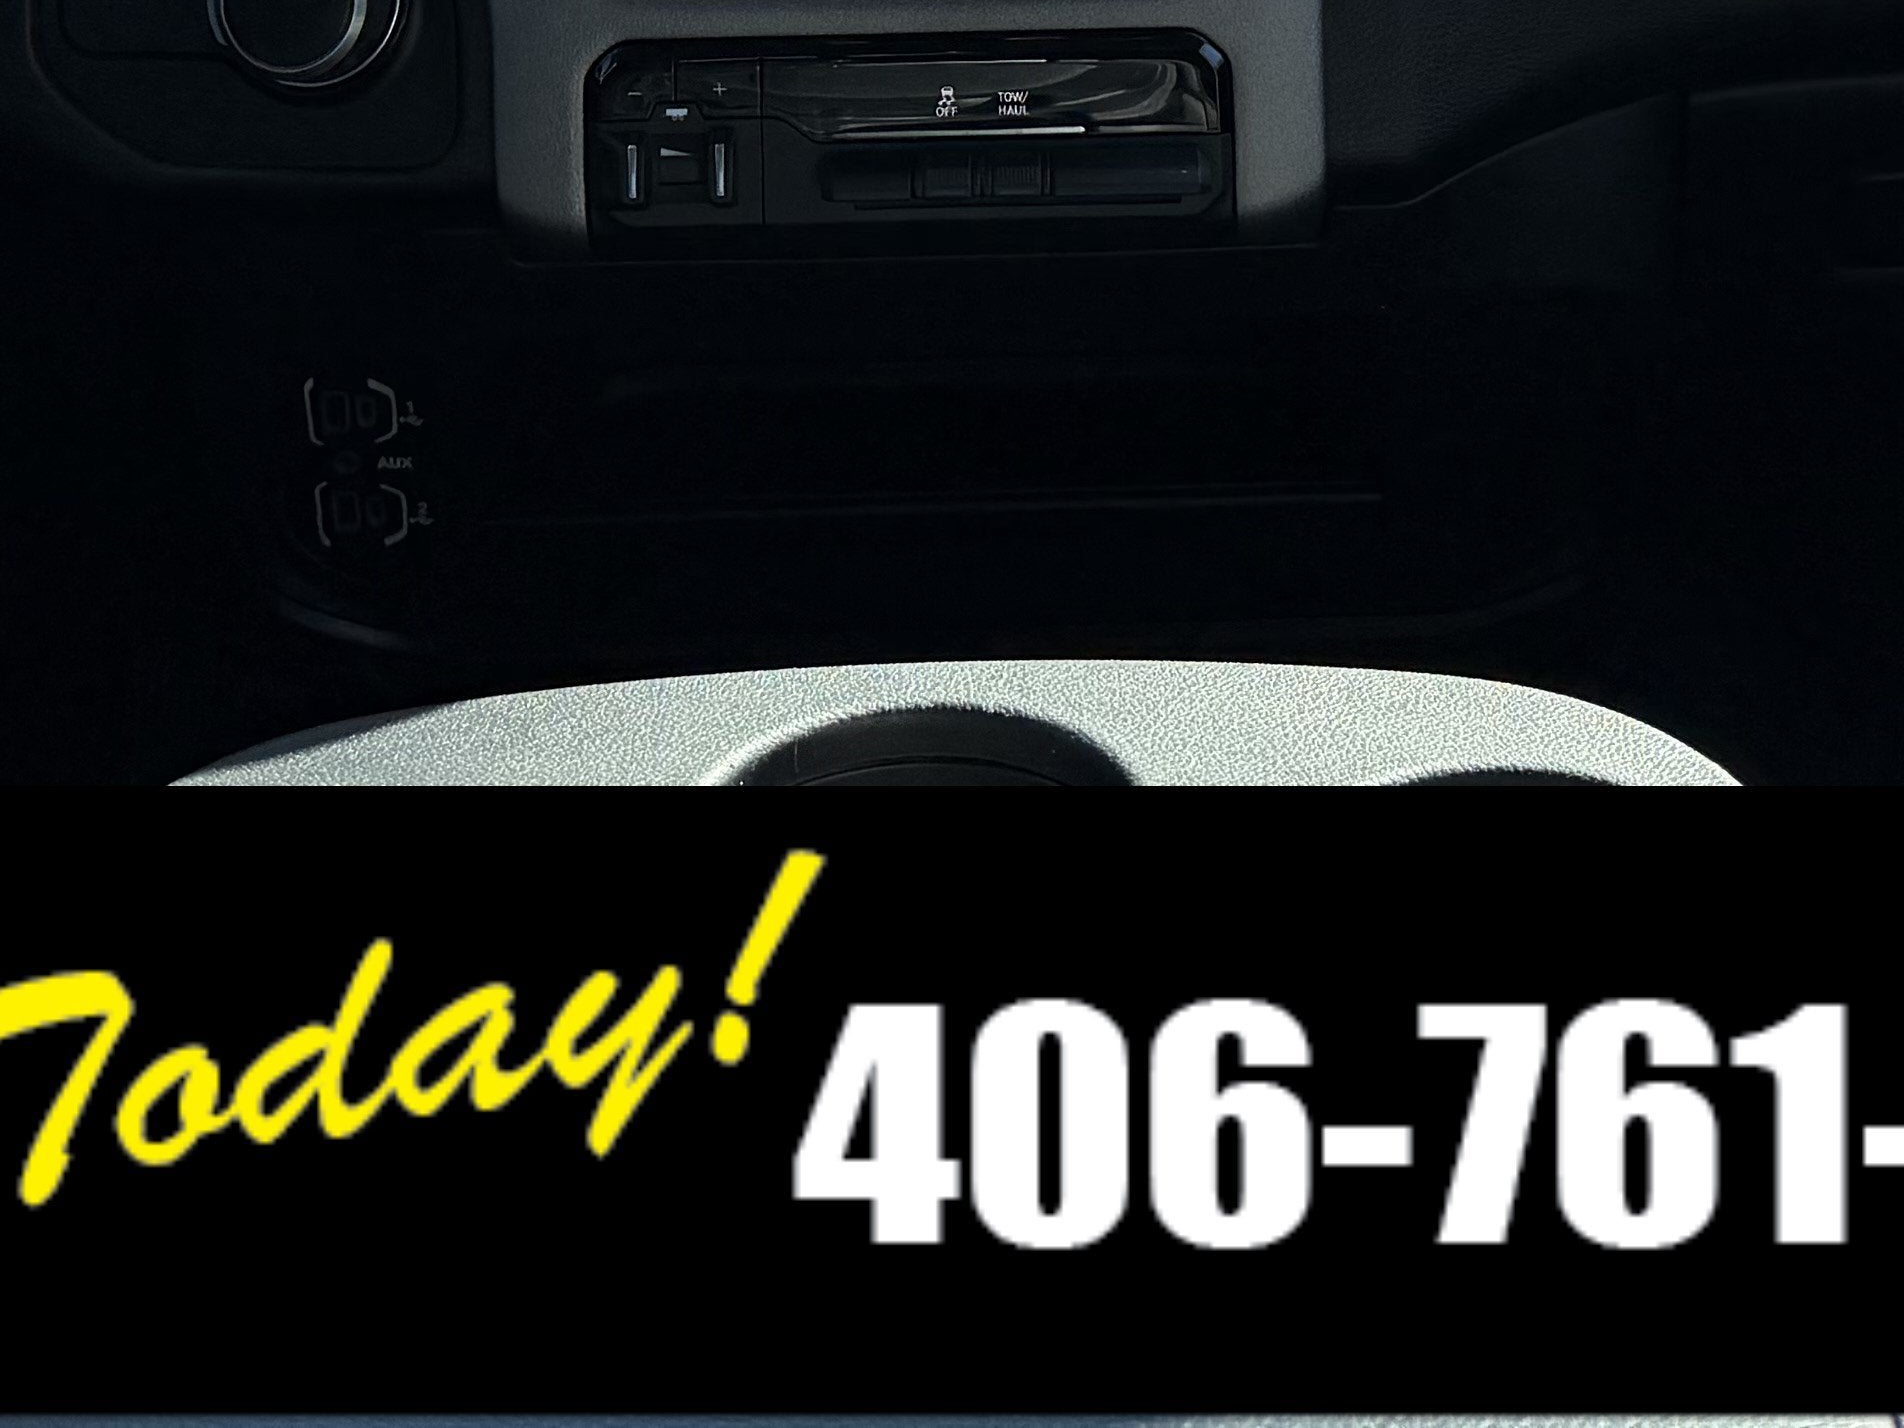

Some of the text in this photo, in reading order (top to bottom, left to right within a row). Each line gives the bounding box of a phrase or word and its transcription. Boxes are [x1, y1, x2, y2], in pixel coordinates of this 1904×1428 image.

[997, 90, 1030, 104] TOW/
[935, 106, 958, 118] OFF
[997, 104, 1030, 117] HAUL
[376, 455, 415, 470] AUX
